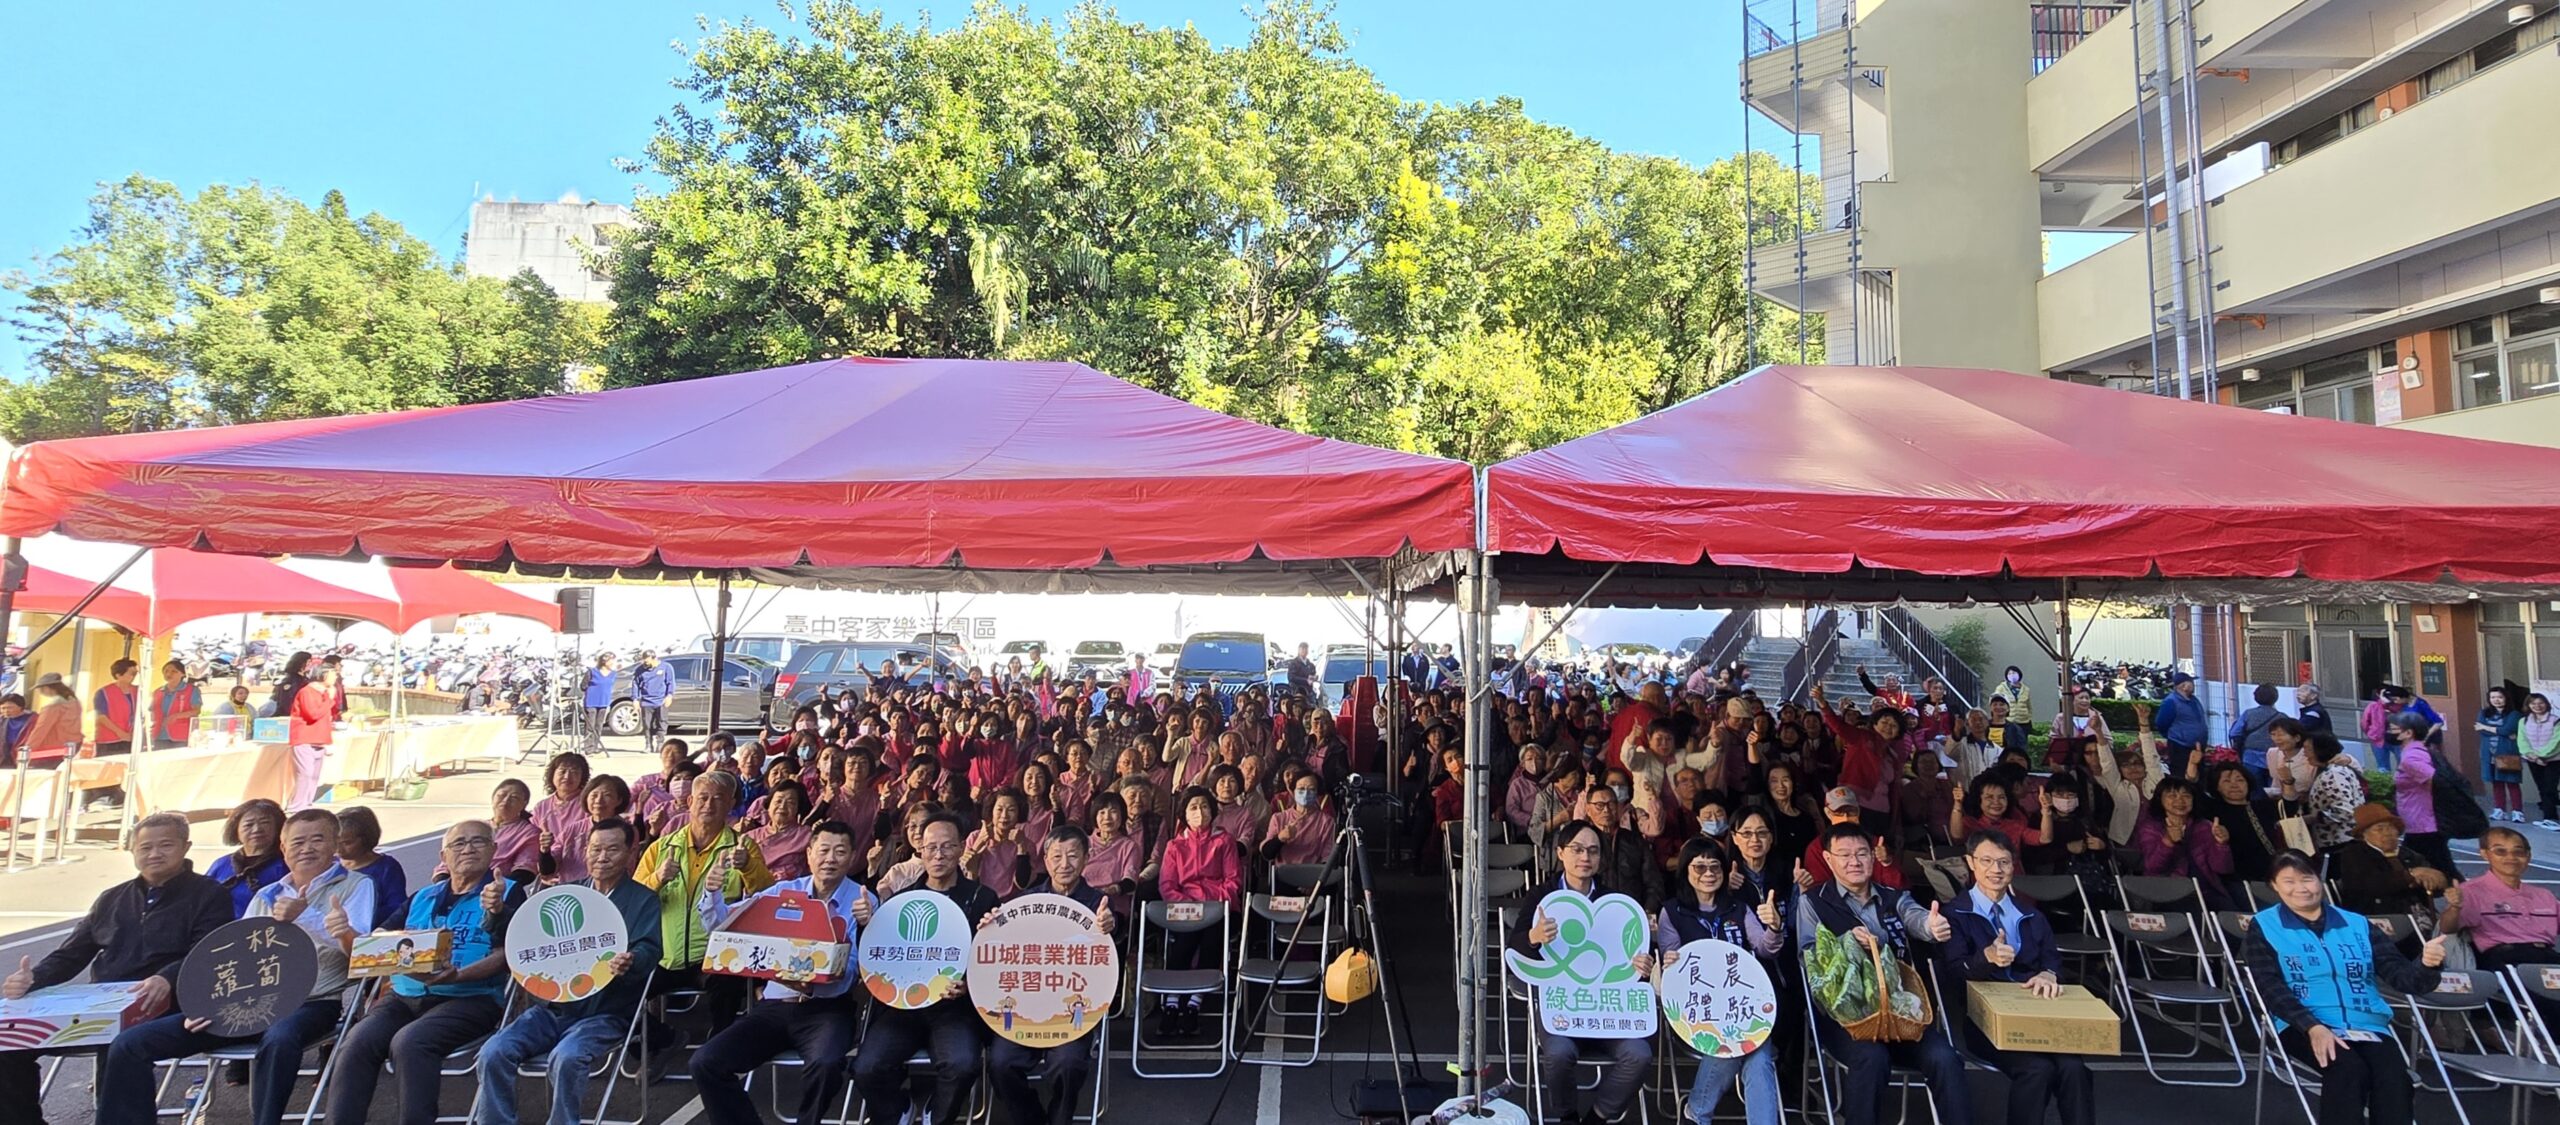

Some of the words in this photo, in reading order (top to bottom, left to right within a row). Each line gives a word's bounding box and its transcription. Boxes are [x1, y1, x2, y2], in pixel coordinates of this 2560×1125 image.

[995, 903, 1093, 931] 臺中市政府農業局
[211, 926, 289, 953] 一根
[517, 932, 616, 965] 東勢區農會
[868, 946, 961, 961] 東勢區農會
[977, 944, 1110, 966] 山城農業推廣
[211, 954, 279, 999] 蘿蔔
[998, 971, 1088, 993] 學習中心
[1678, 951, 1755, 989] 食農
[1546, 985, 1650, 1013] 綠色照顧
[1684, 990, 1764, 1023] 體驗
[1572, 1017, 1648, 1031] 東勢區農會
